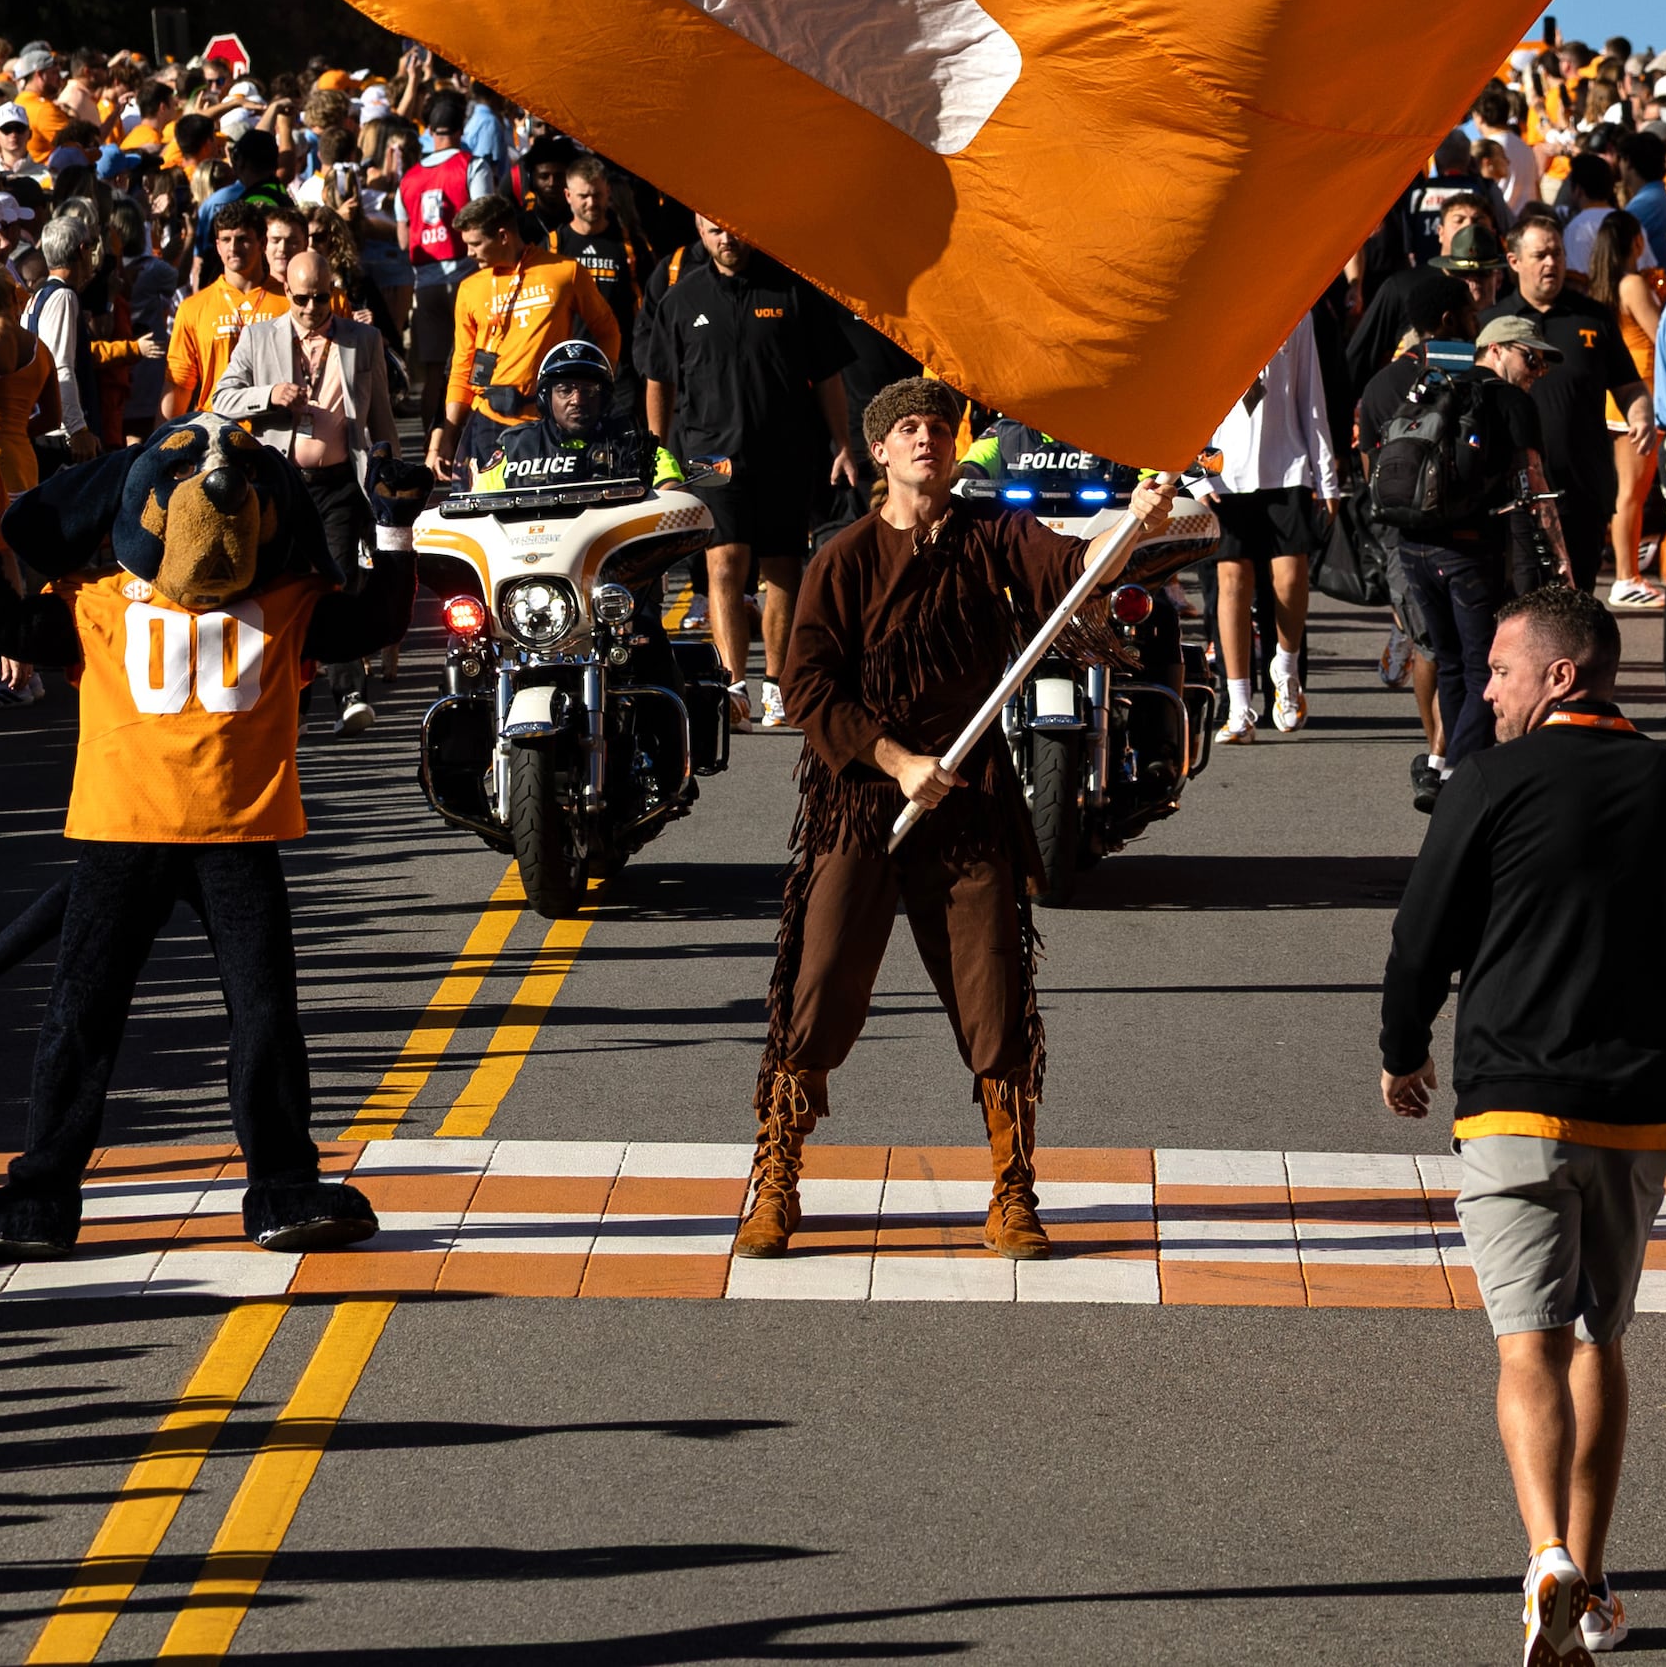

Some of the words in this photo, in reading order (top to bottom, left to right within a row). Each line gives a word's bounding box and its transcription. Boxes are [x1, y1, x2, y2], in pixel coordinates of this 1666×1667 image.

[422, 226, 448, 245] 018
[513, 309, 531, 328] T
[754, 307, 784, 319] VOLS
[1578, 329, 1597, 348] T
[503, 455, 577, 479] POLICE
[1018, 452, 1091, 470] POLICE
[124, 579, 152, 600] SEC
[124, 598, 265, 715] 00
